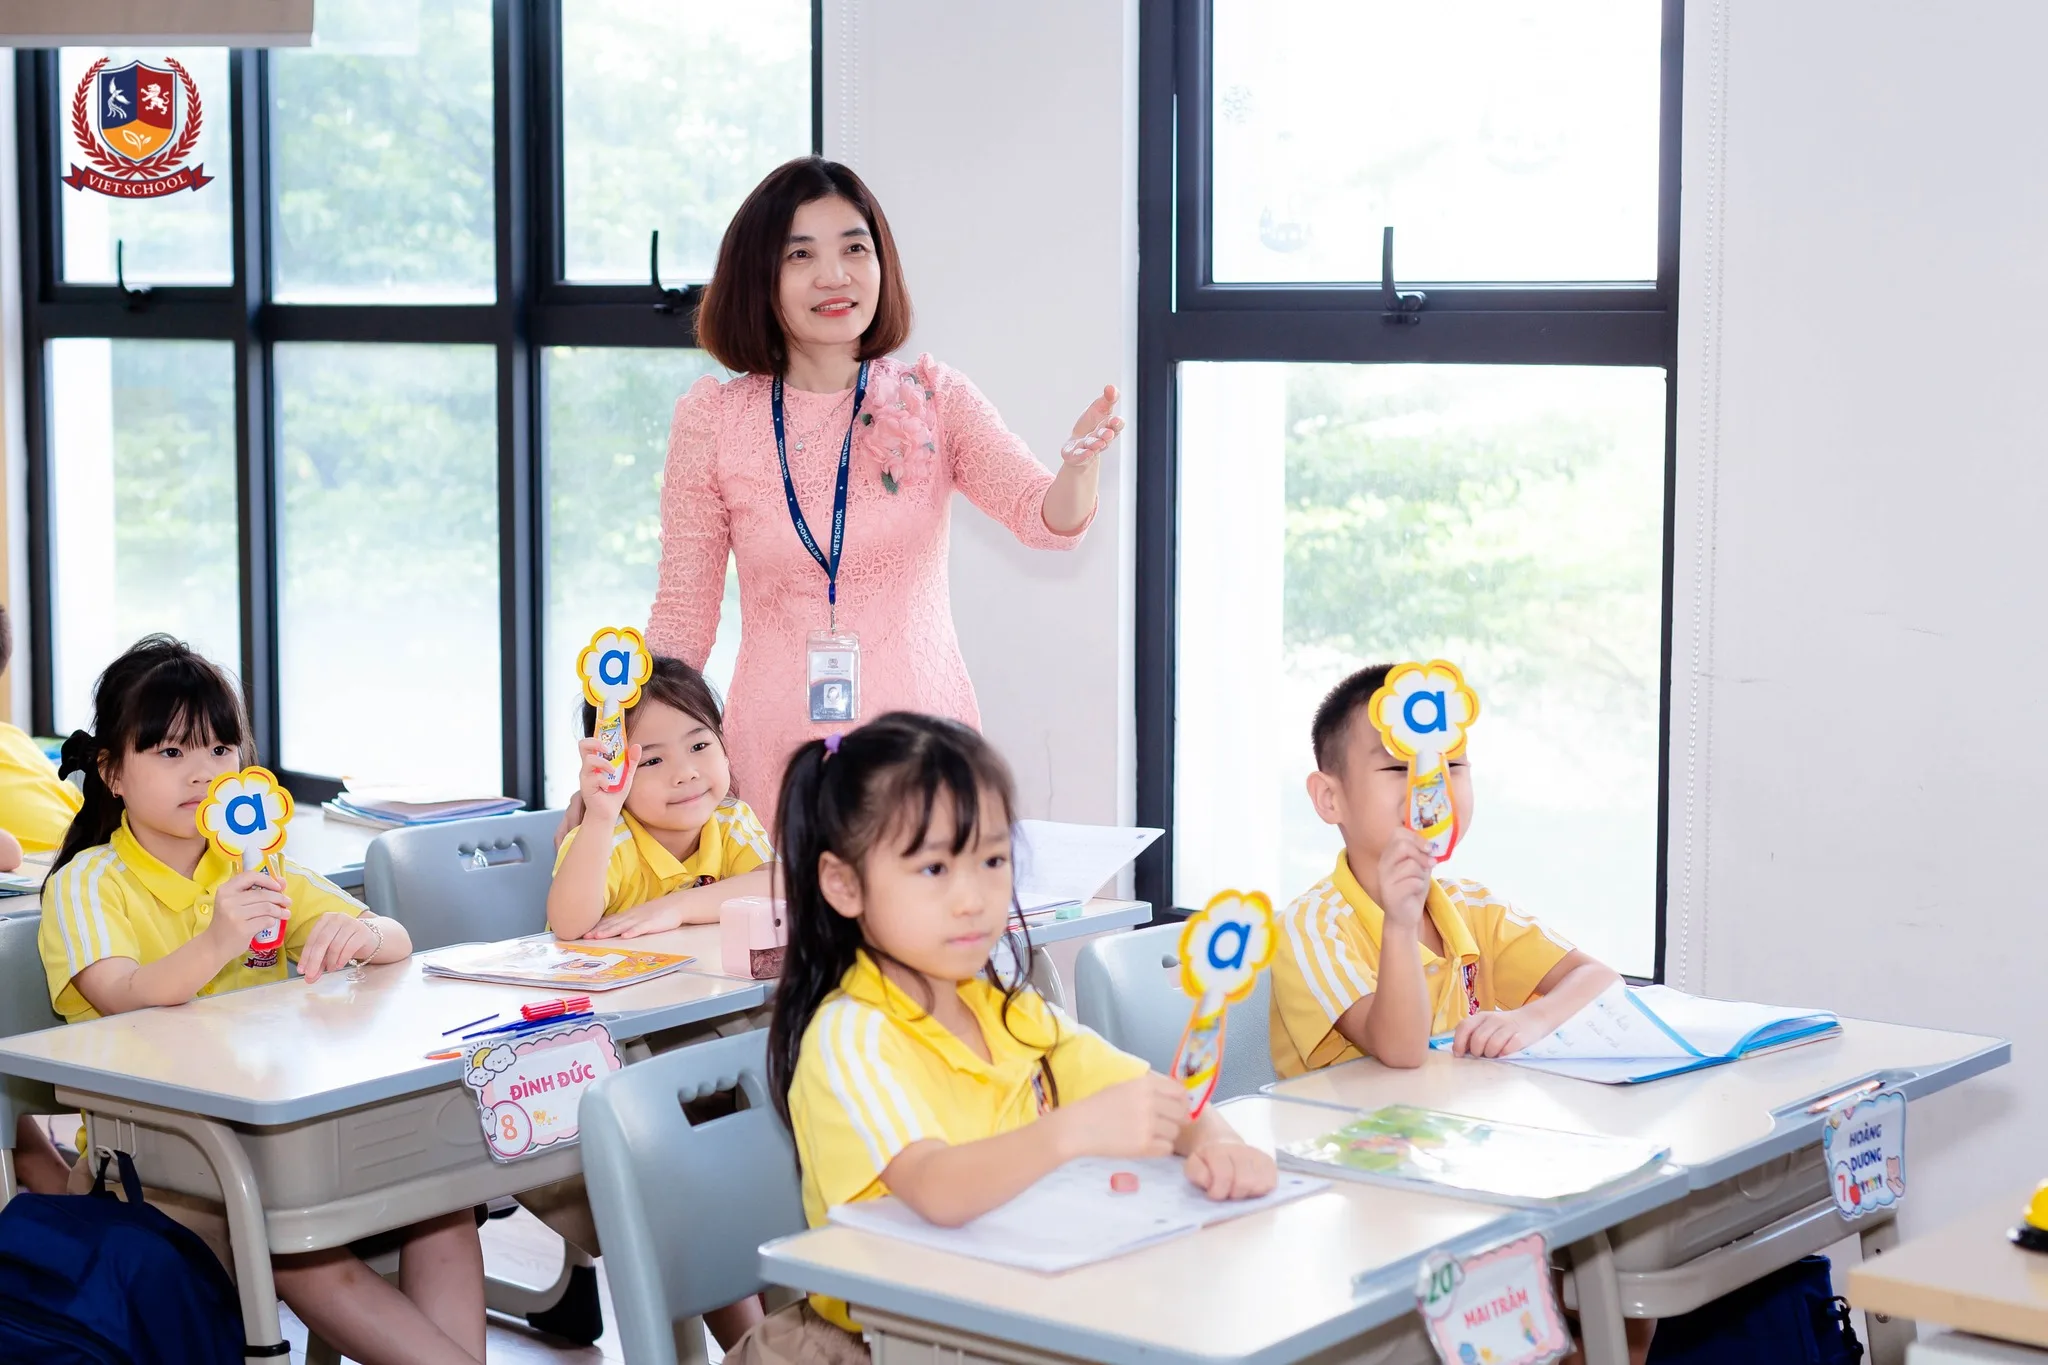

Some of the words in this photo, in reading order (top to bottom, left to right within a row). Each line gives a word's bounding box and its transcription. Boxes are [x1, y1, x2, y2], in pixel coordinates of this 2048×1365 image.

[796, 518, 823, 562] VIETSCHOOL
[832, 508, 843, 556] VIETSCHOOL
[599, 649, 630, 686] a
[1403, 690, 1447, 734] a
[225, 793, 268, 836] a
[1207, 921, 1251, 970] a
[510, 1075, 554, 1101] ĐÌNH
[556, 1060, 596, 1088] ĐỨC
[501, 1114, 518, 1141] 8
[1837, 1174, 1846, 1202] 7
[1426, 1263, 1454, 1304] 20
[1464, 1304, 1491, 1329] MAI
